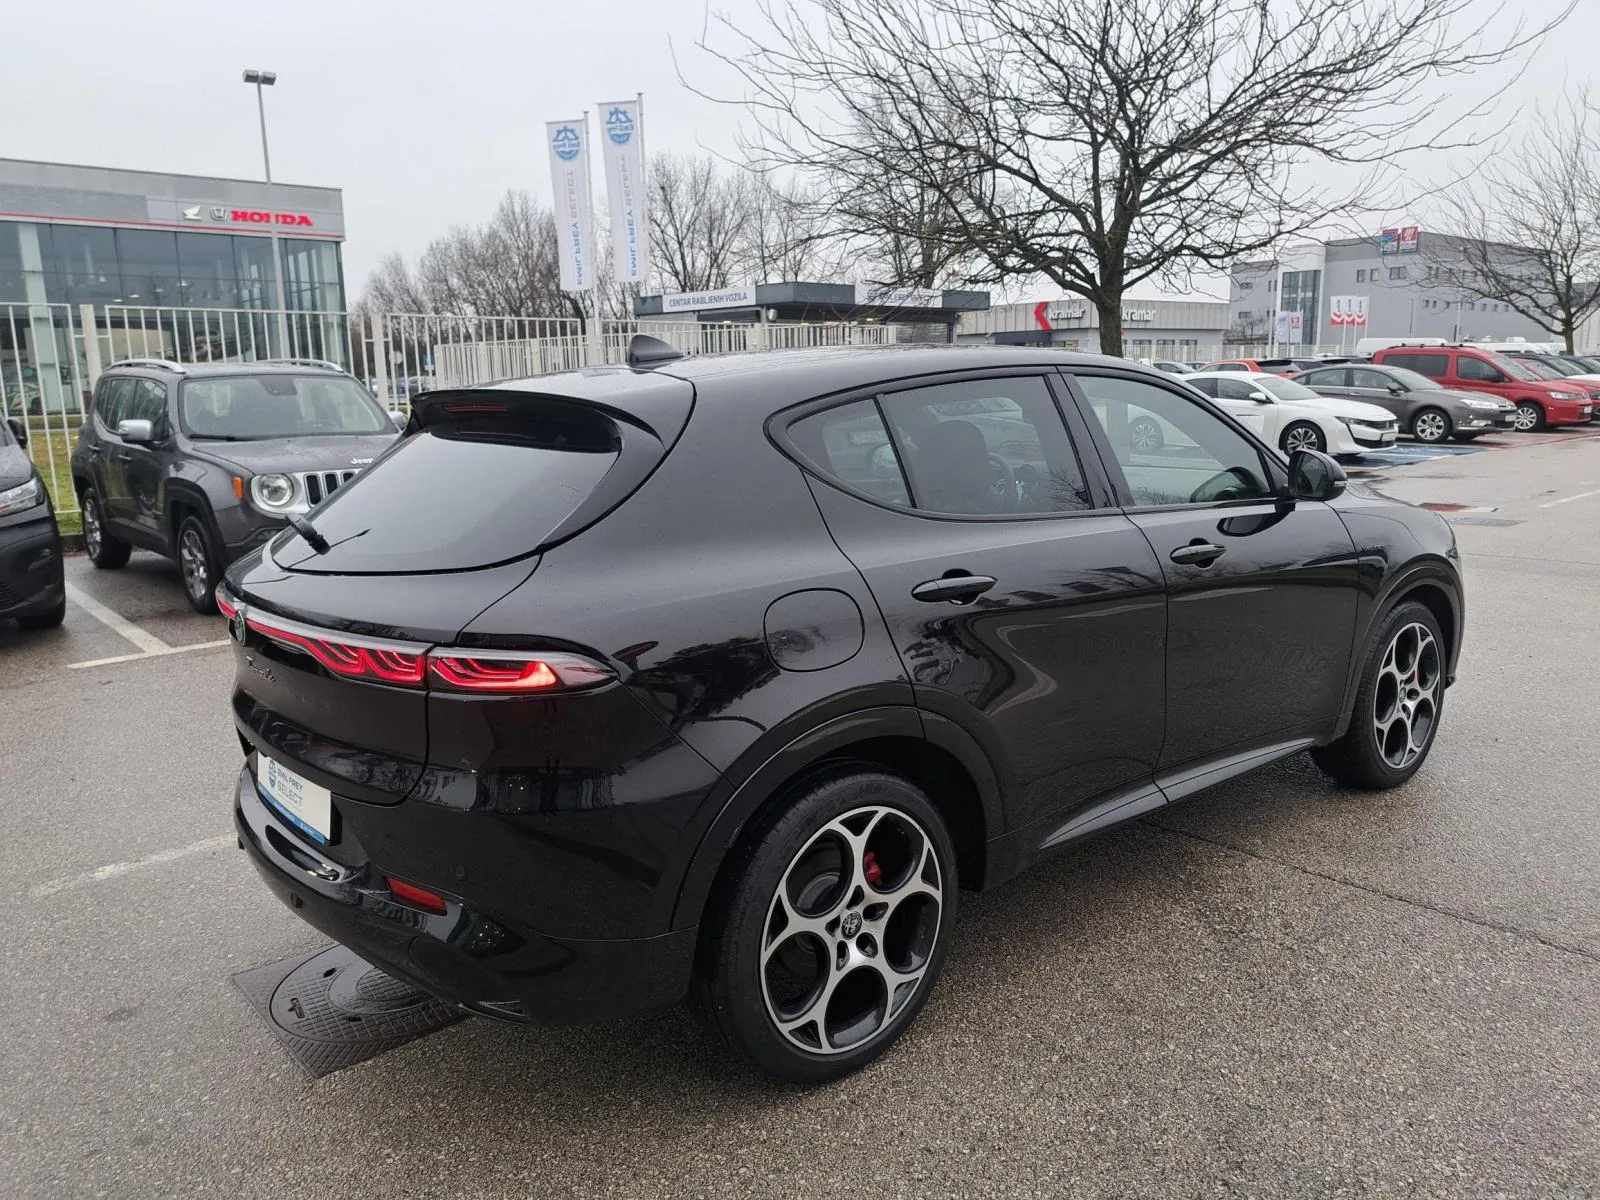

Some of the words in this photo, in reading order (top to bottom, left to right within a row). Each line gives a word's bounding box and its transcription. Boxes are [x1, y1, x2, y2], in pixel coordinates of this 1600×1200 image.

[231, 210, 313, 226] HONDA
[669, 298, 691, 307] CENTAR
[725, 292, 747, 302] VOZILA
[1049, 307, 1085, 319] kramar
[1121, 306, 1156, 320] kramar
[277, 768, 289, 784] EMIL
[289, 777, 304, 793] FREY
[277, 780, 304, 807] SELECT
